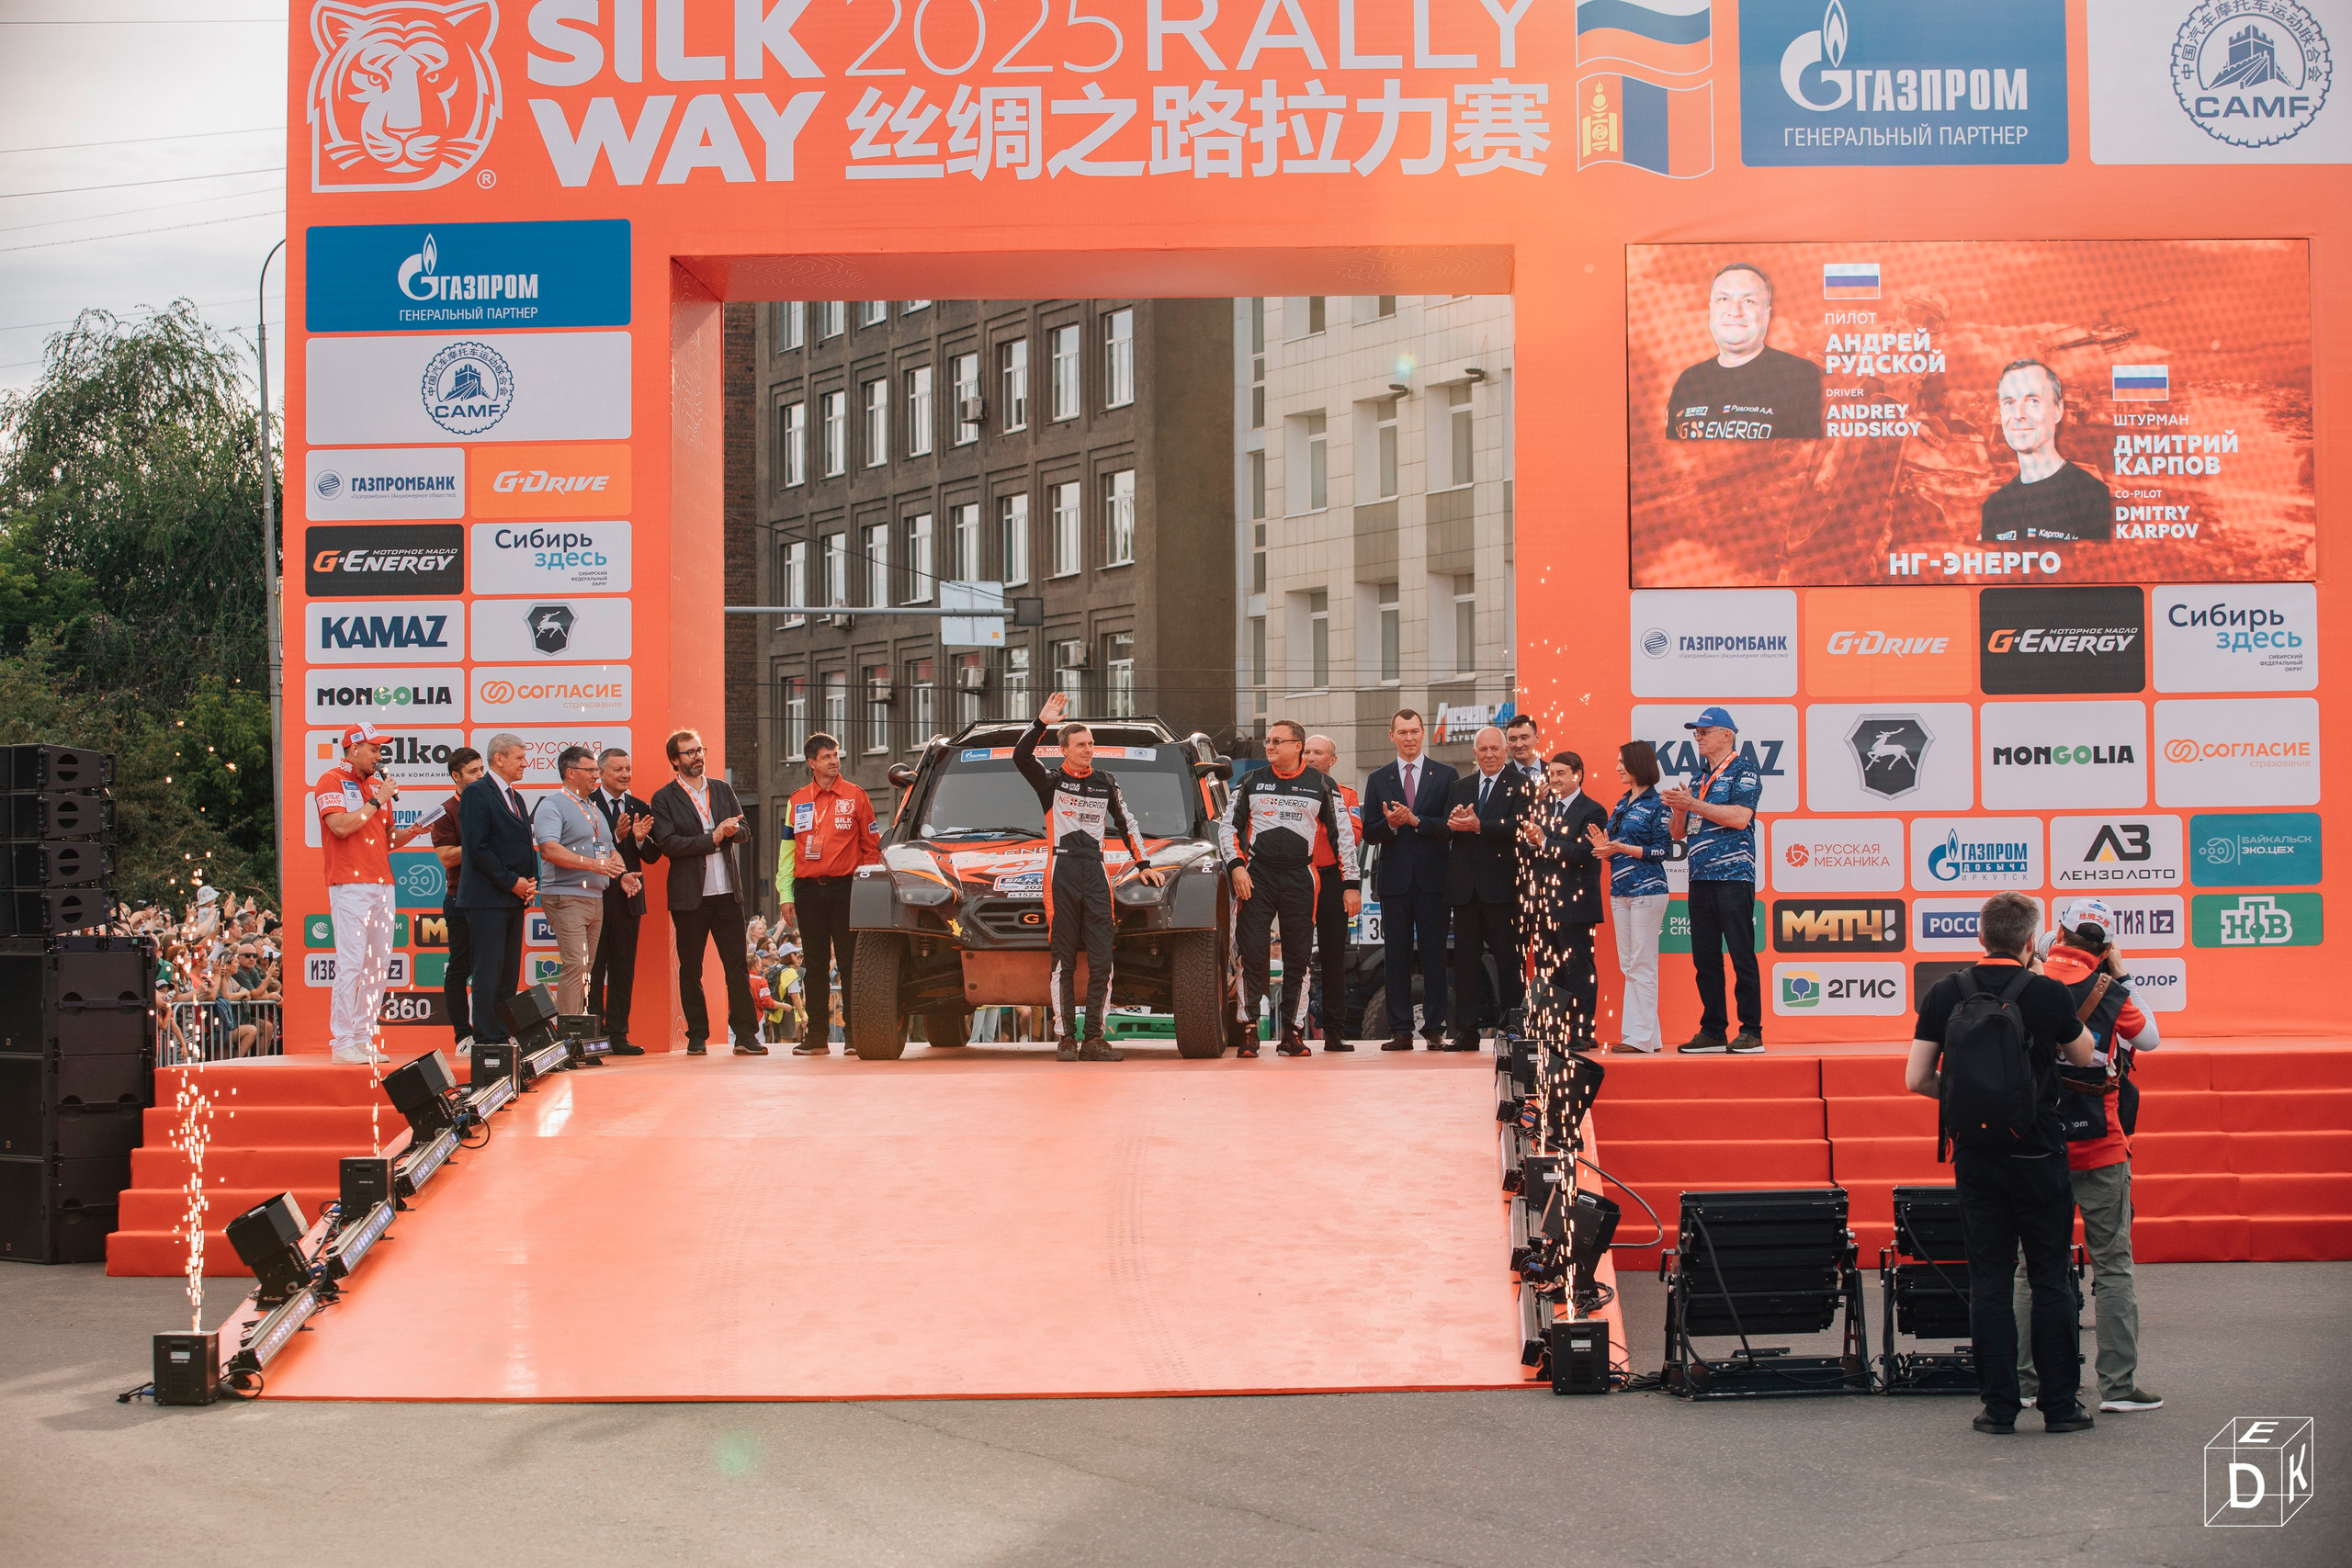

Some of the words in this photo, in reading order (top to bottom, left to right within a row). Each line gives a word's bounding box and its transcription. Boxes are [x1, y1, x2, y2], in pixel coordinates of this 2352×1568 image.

[527, 0, 826, 86] SILK
[844, 0, 1123, 75] 2025
[1148, 0, 1540, 72] RALLY
[1854, 69, 2029, 111] ГАЗПРОМ
[2195, 96, 2310, 118] CAMF
[527, 91, 826, 186] WAY
[844, 77, 1552, 182] 丝绸之路拉力赛
[1783, 122, 1931, 147] ГЕНЕРАЛЬНЫЙ
[1939, 125, 2029, 146] ПАРТНЕР
[440, 274, 538, 300] ГАЗПРОМ
[399, 306, 483, 321] ГЕНЕРАЛЬНЫЙ
[487, 307, 538, 320] ПАРТНЕР
[1825, 312, 1877, 324] ПИЛОТ
[1826, 328, 1930, 355] АНДРЕЙ
[1826, 349, 1946, 377] РУДСКОЙ
[1826, 389, 1864, 398] DRIVER
[435, 404, 501, 418] CAMF
[1826, 403, 1909, 420] ANDREY
[2113, 413, 2189, 426] ШТУРМАН
[1705, 421, 1772, 439] ENERGO
[1826, 422, 1922, 437] RUDSKOY
[2113, 430, 2239, 457] ДМИТРИЙ
[2114, 457, 2221, 475] КАРПОВ
[352, 476, 456, 491] ГАЗПРОМБАНК
[2115, 489, 2162, 499] CO-PILOT
[2115, 506, 2190, 522] DMITRY
[494, 527, 593, 553] Сибирь
[2115, 524, 2199, 539] KARPOV
[534, 550, 607, 570] здесь
[1889, 551, 2062, 576] НГ-ЭНЕРГО
[2167, 602, 2285, 633] Сибирь
[322, 615, 448, 649] KAMAZ
[1679, 636, 1788, 651] ГАЗПРОМБАНК
[2215, 630, 2302, 653] здесь
[317, 686, 452, 706] MONGOLIA
[517, 683, 623, 699] СОГЛАСИЕ
[562, 700, 623, 710] страхование
[379, 738, 452, 764] elko
[1647, 740, 1785, 776] KAAZ
[1993, 745, 2134, 765] MONGOLIA
[2202, 742, 2311, 757] СОГЛАСИЕ
[2249, 759, 2311, 769] страхование
[1278, 799, 1308, 808] ENERGO
[392, 810, 422, 824] ПРОМ
[2242, 834, 2312, 844] БАЙКАЛЬСК
[1814, 843, 1881, 854] РУССКАЯ
[1962, 842, 2028, 860] ГАЗПРОМ
[2242, 846, 2295, 855] ЭКО.ЦЕХ
[1814, 855, 1891, 867] МЕХАНИКА
[1963, 863, 2027, 873] ДОБЫЧА
[1962, 873, 2029, 882] ИРКУТСК
[2060, 868, 2176, 881] ЛЕНЗОЛОТО
[1781, 909, 1896, 942] МАТЧ!
[1929, 917, 1980, 933] РОСС
[2221, 896, 2293, 945] НТВ
[1827, 978, 1896, 998] 2ГИС
[385, 998, 432, 1021] 360
